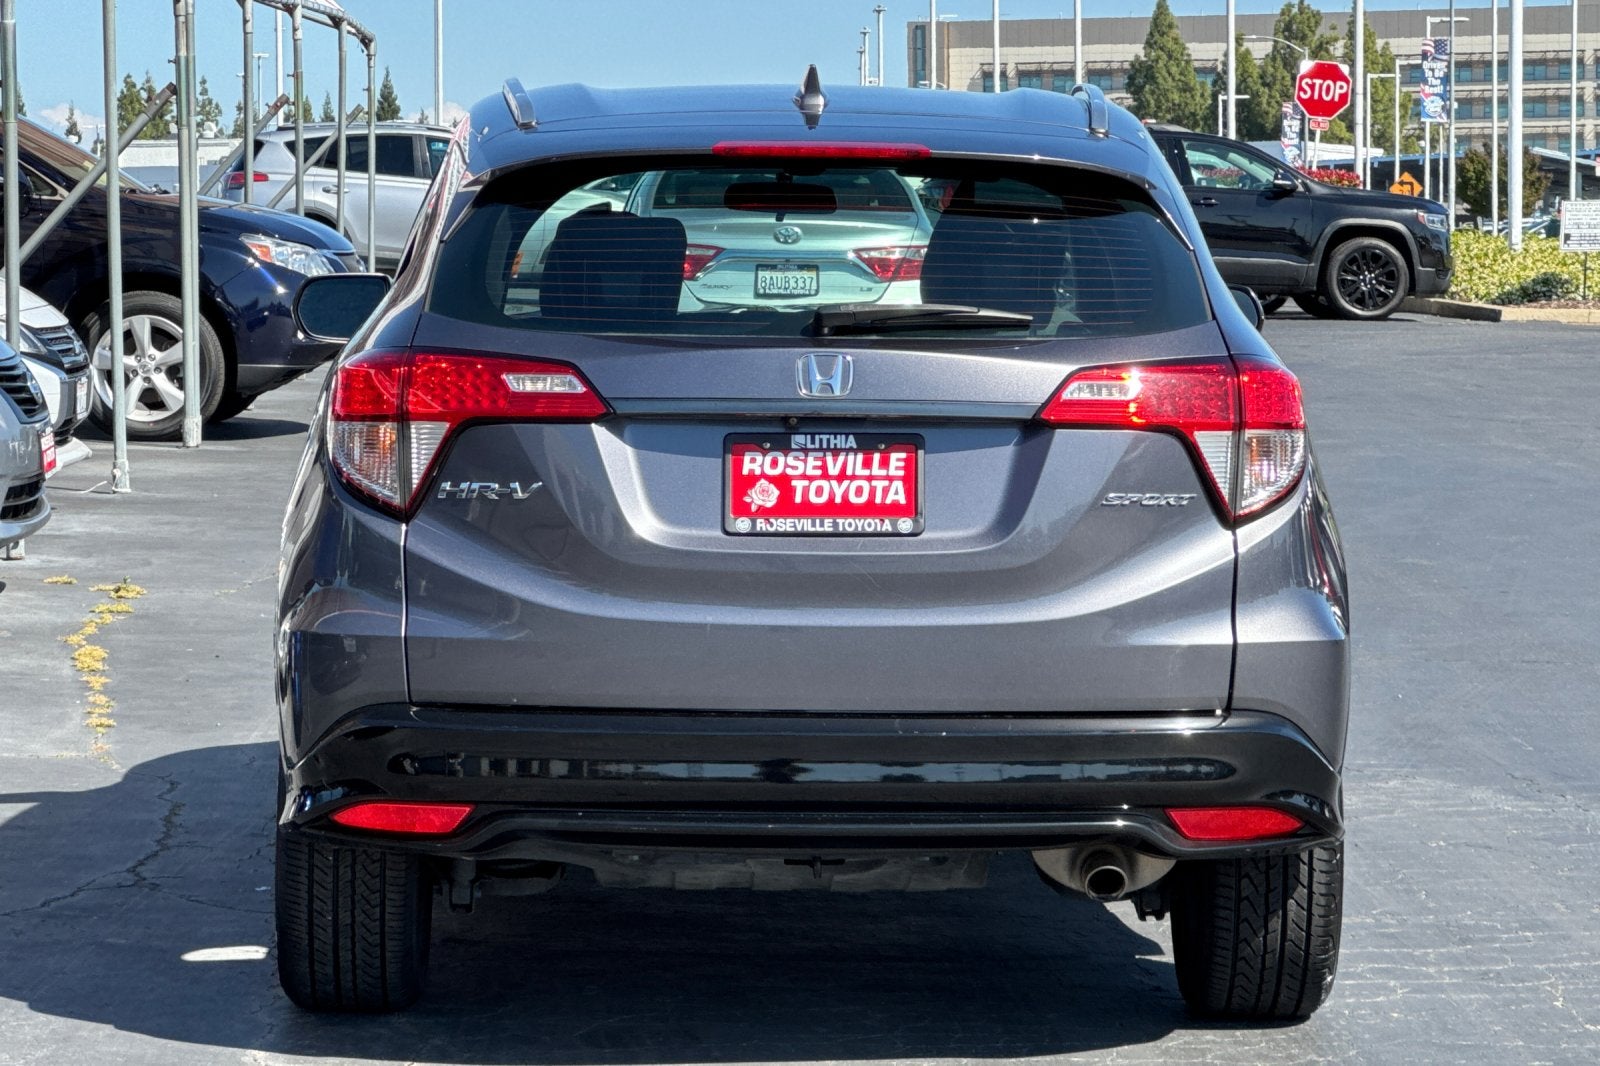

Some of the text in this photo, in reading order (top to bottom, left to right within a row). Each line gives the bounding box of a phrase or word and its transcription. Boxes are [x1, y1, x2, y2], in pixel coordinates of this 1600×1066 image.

[1299, 78, 1348, 102] STOP
[760, 275, 814, 290] 8AUB337
[805, 434, 857, 449] LITHIA
[742, 451, 907, 476] ROSEVILLE
[437, 481, 543, 500] HR-V
[791, 479, 907, 505] TOYOTA
[1102, 493, 1198, 505] SPORT
[756, 518, 892, 533] ROSEVILLE TOYOTA
